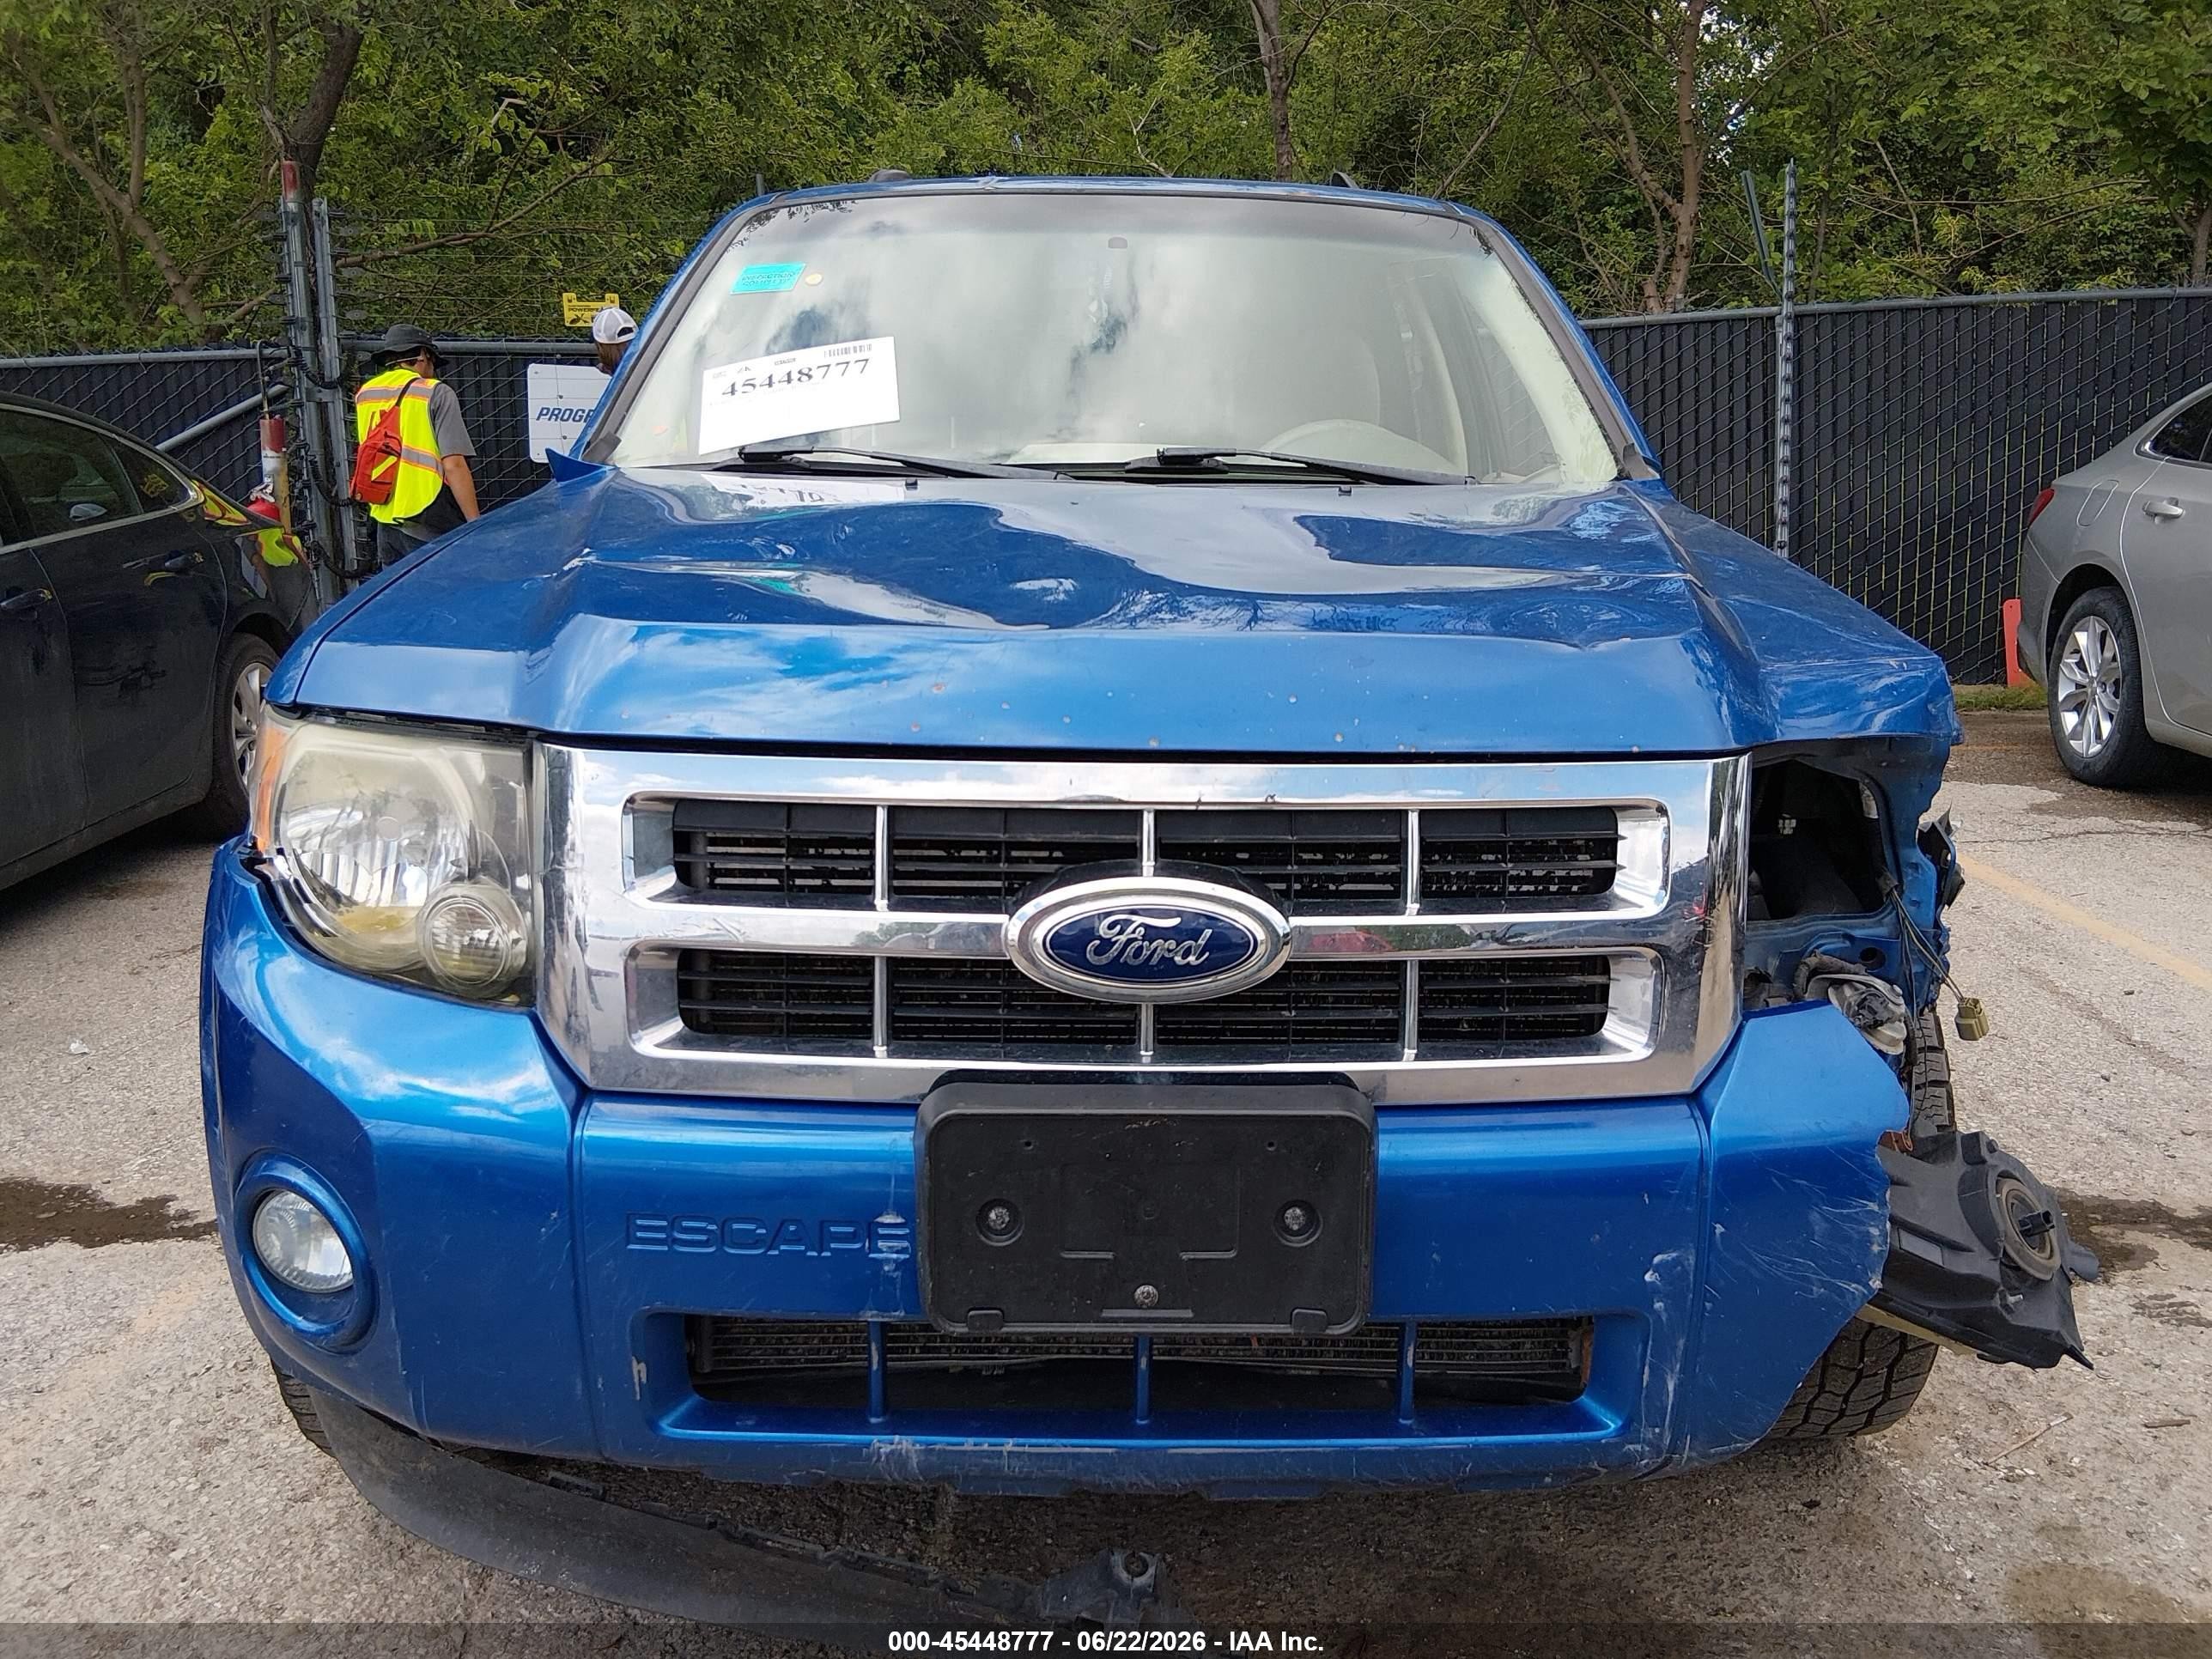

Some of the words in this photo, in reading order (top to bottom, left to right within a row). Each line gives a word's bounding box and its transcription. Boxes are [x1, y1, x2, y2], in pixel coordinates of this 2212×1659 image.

[721, 358, 870, 397] 45448777
[1085, 913, 1213, 966] Ford
[625, 1212, 911, 1259] ESCAPE
